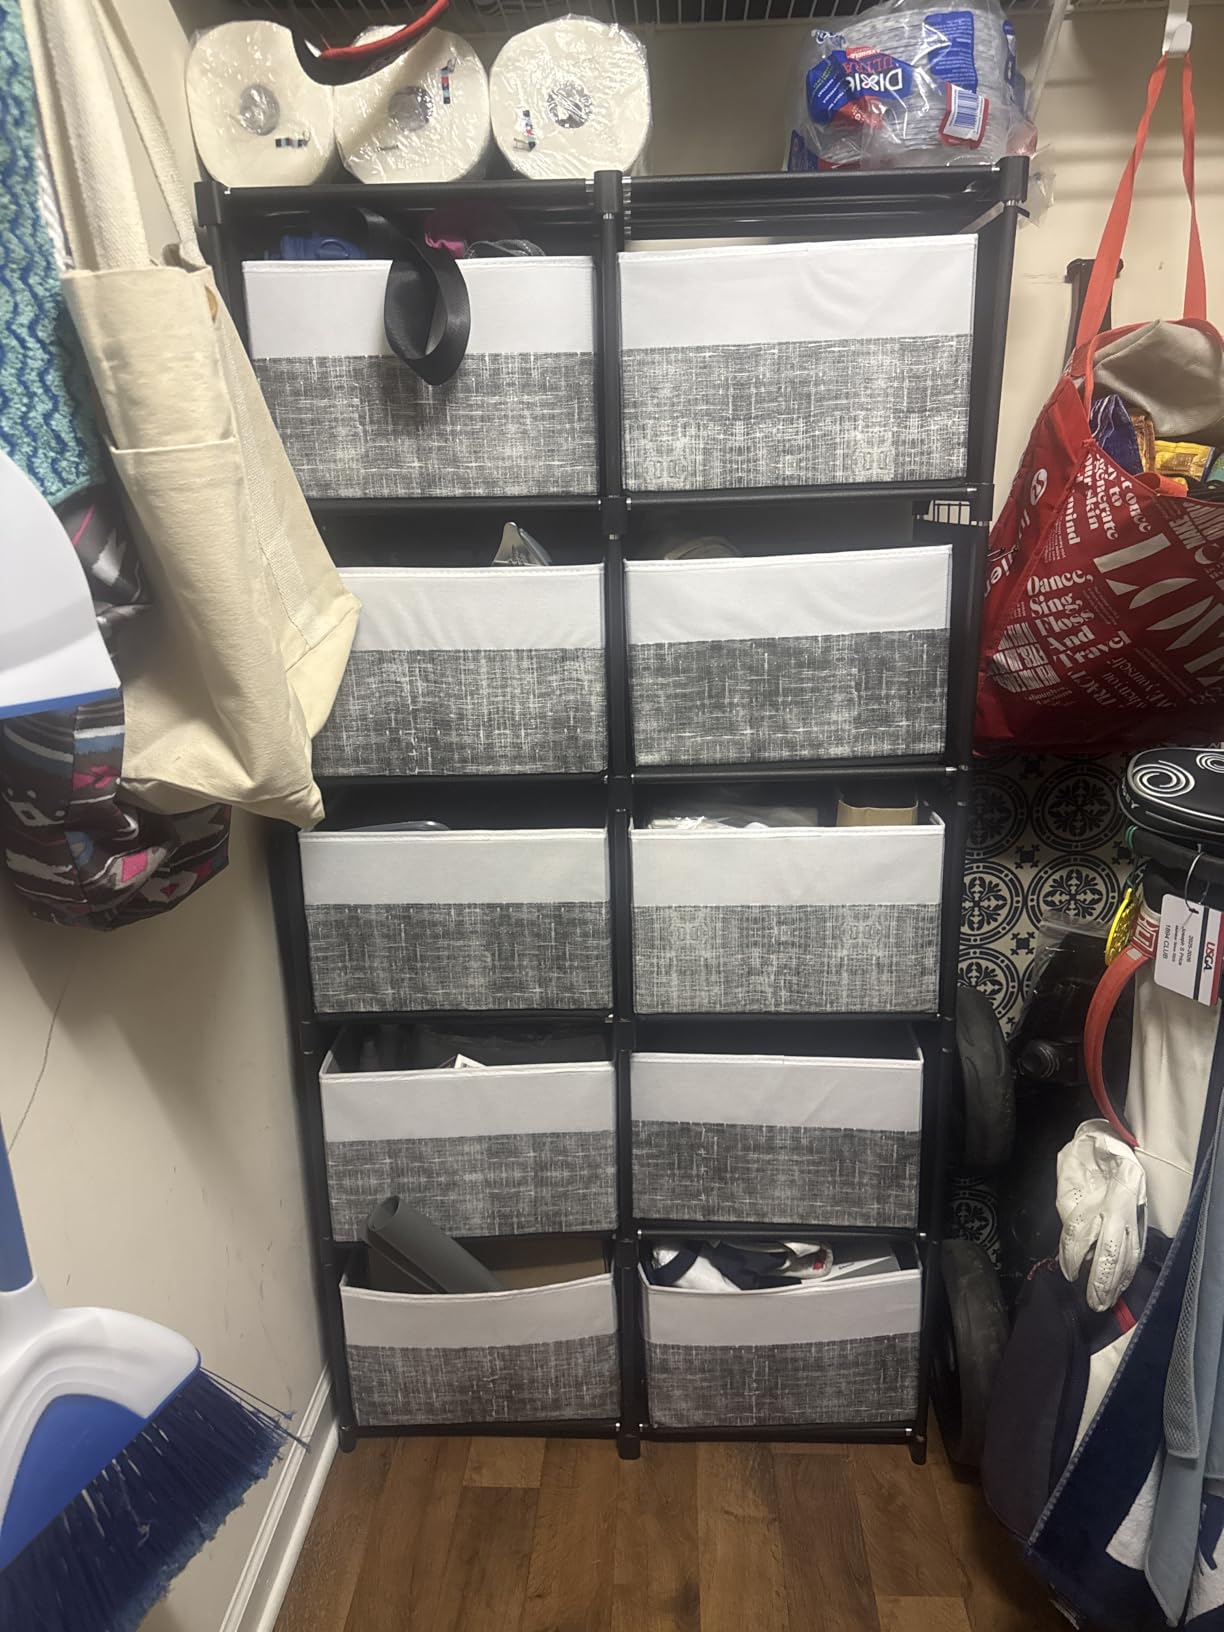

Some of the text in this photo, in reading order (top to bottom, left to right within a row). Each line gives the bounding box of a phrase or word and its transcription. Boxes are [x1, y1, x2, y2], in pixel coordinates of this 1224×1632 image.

[842, 56, 894, 74] ULTRA
[1085, 489, 1100, 530] skin
[1109, 486, 1123, 507] to
[1065, 495, 1081, 545] mind
[1126, 492, 1152, 533] once
[1168, 514, 1207, 550] MAKE
[1027, 569, 1094, 597] Dance,
[1029, 592, 1083, 618] Sing,
[1035, 609, 1095, 637] Floss
[1046, 624, 1096, 652] And
[1052, 629, 1132, 668] Travel
[1162, 940, 1170, 960] CLUB
[1204, 941, 1215, 970] USGA
